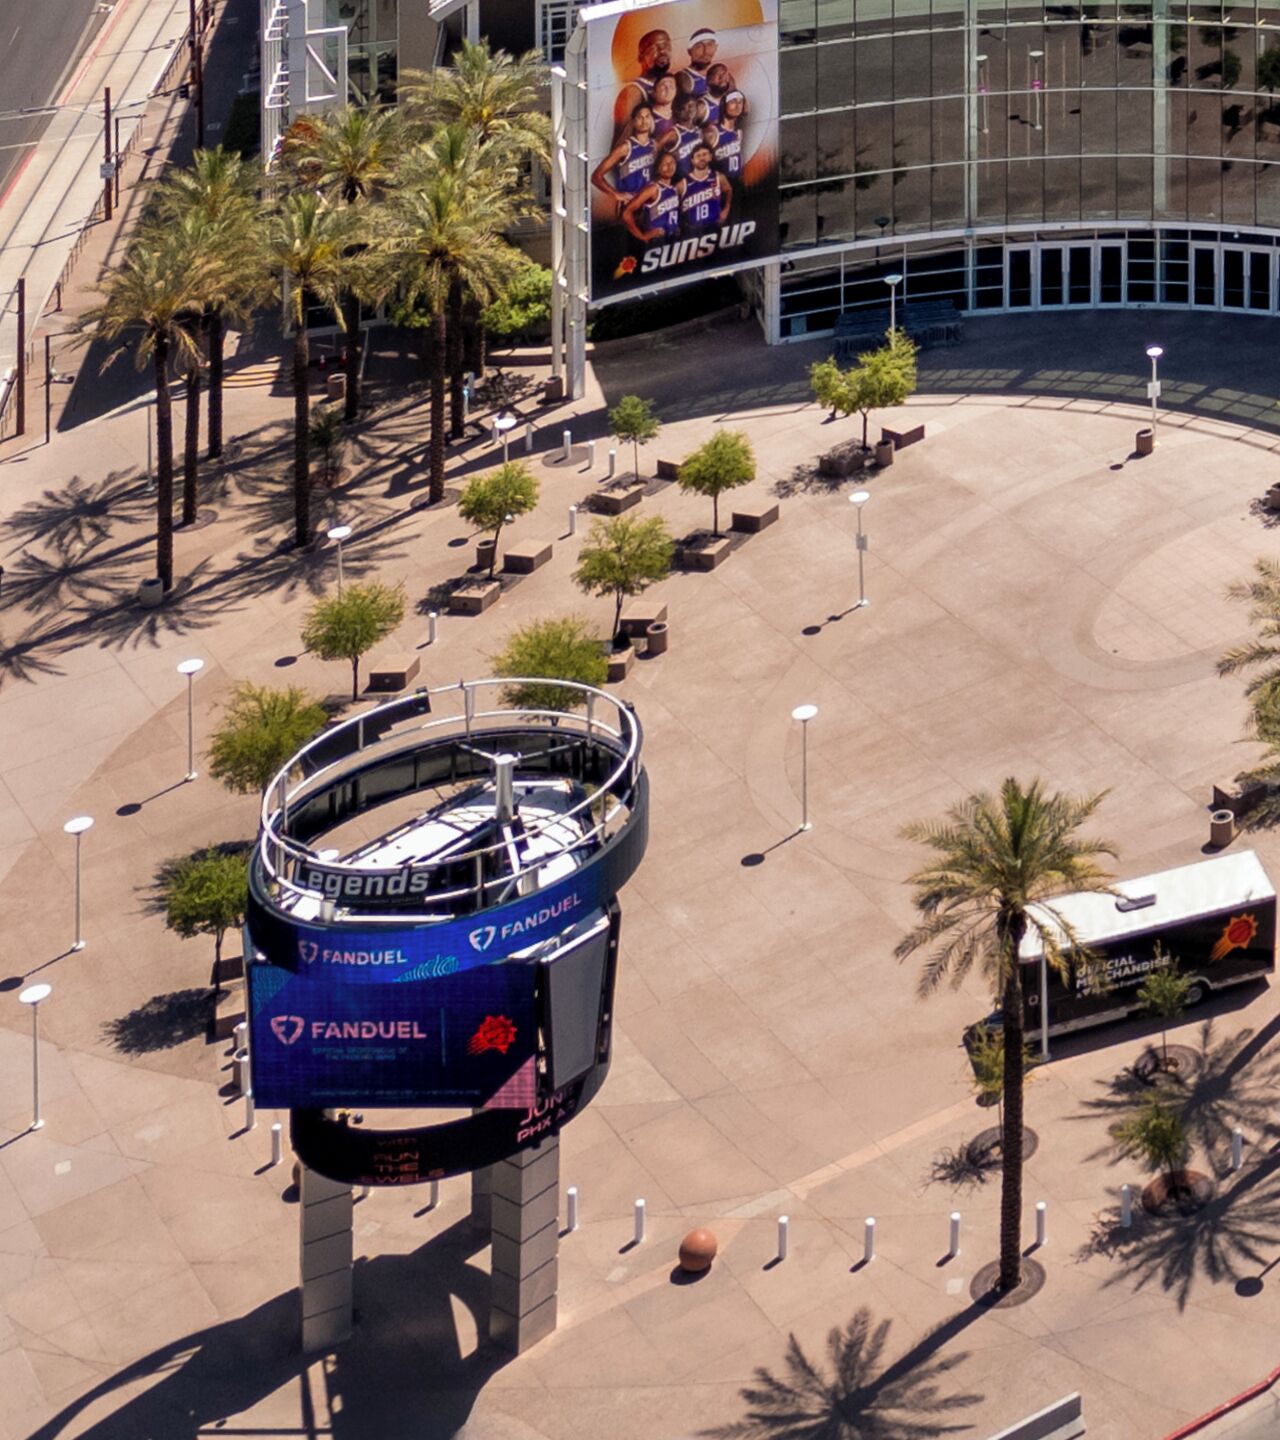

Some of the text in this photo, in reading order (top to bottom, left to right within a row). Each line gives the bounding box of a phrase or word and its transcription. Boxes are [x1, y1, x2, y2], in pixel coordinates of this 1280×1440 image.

[683, 187, 713, 212] SUNS
[696, 204, 709, 221] 18
[641, 220, 756, 273] SUNS UP
[295, 863, 430, 898] Legends
[501, 893, 582, 940] FANDUEL
[322, 949, 408, 965] FANDUEL
[312, 1021, 427, 1039] FANDUEL
